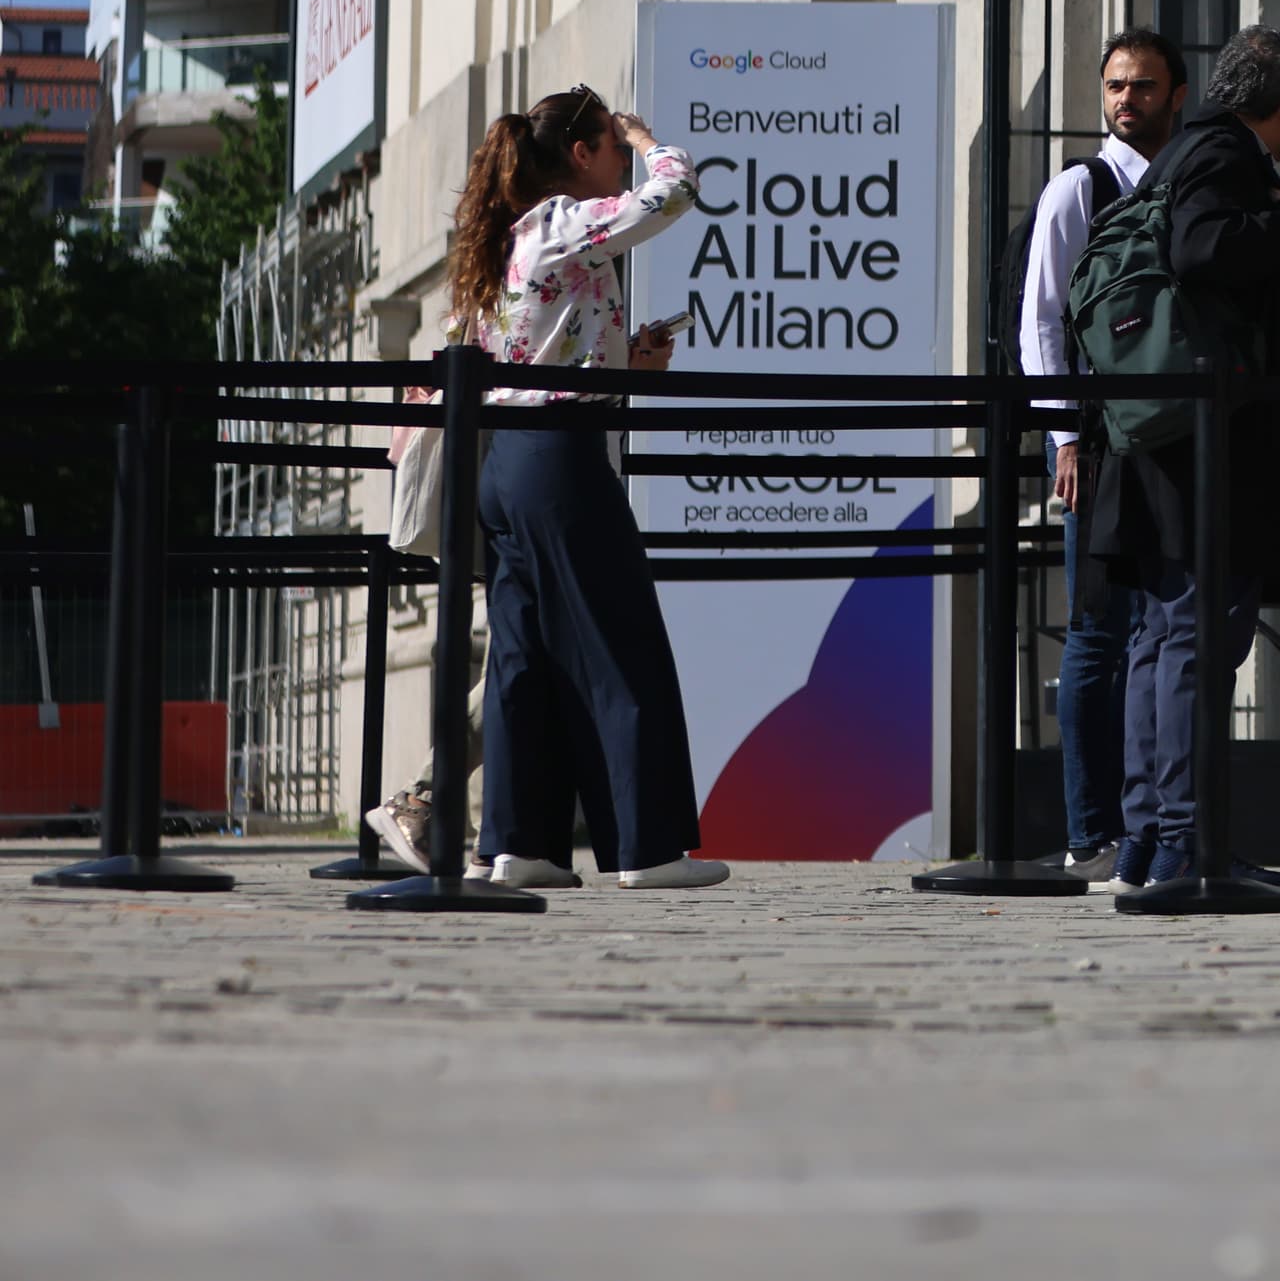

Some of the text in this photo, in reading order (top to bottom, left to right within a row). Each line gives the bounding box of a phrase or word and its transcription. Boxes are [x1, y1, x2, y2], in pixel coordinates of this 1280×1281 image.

[690, 49, 826, 74] Google Cloud
[690, 102, 900, 134] Benvenuti al
[695, 156, 898, 217] Cloud
[689, 224, 900, 281] AI Live
[688, 291, 899, 350] Milano
[797, 430, 835, 445] tuo
[685, 502, 868, 526] per accedere alla
